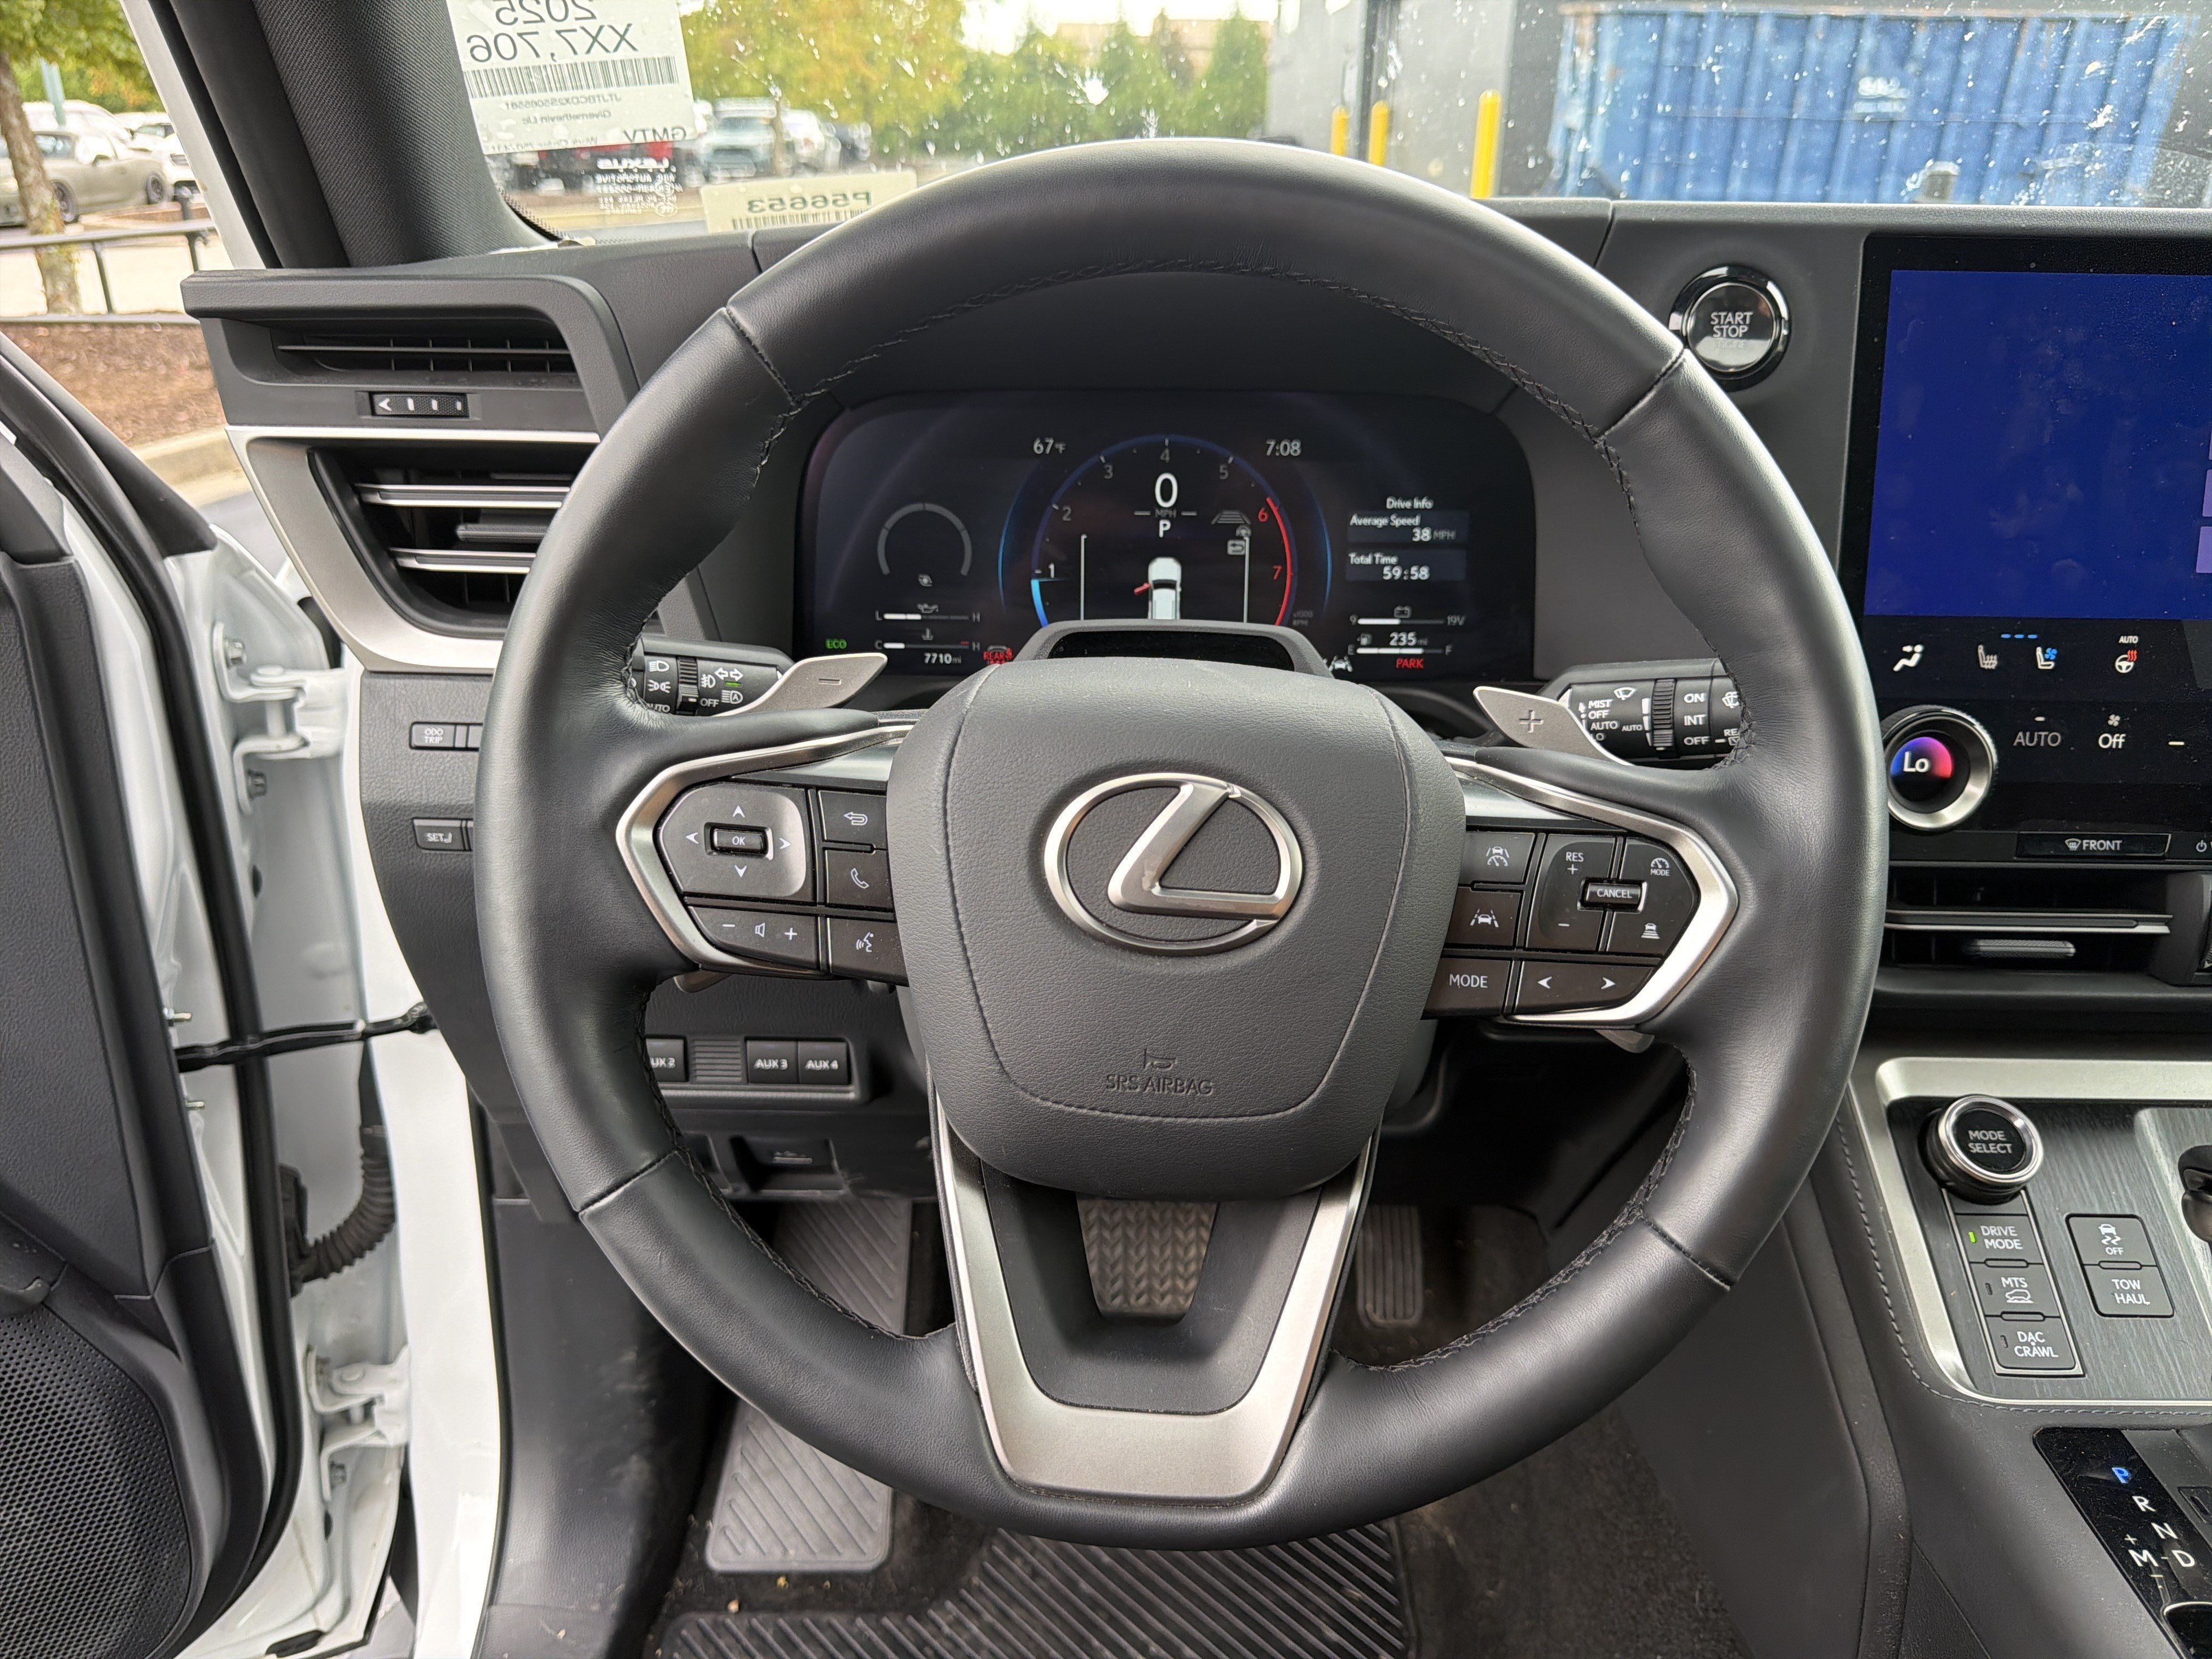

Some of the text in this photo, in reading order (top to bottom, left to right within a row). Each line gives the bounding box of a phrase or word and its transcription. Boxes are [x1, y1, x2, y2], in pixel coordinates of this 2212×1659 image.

[1710, 311, 1753, 325] START
[1713, 325, 1749, 338] STOP
[1266, 439, 1301, 456] 7:08
[1159, 448, 1170, 464] 4
[1103, 464, 1114, 479] 3
[1219, 464, 1229, 480] 5
[1155, 472, 1178, 507] 0
[1386, 495, 1435, 509] Drive Info
[1062, 505, 1072, 521] 2
[1258, 507, 1269, 522] 6
[1350, 512, 1421, 528] Average Speed
[1159, 520, 1171, 538] P
[1412, 527, 1432, 541] 38
[1348, 552, 1398, 565] Total Time
[1048, 562, 1055, 579] 1
[1272, 565, 1283, 580] 7
[1382, 565, 1430, 580] 59:58
[825, 637, 848, 649] ECO
[1389, 631, 1417, 645] 235
[2119, 635, 2138, 644] AUTO
[923, 652, 952, 664] 7710
[1396, 658, 1425, 669] PARK
[699, 698, 720, 708] OFF
[1589, 699, 1613, 708] MIST
[1684, 692, 1705, 703] ON
[1588, 709, 1609, 720] OFF
[1684, 714, 1706, 726] INT
[424, 727, 443, 736] ODO
[1590, 721, 1618, 731] AUTO
[1622, 724, 1643, 732] AUTO
[424, 736, 443, 744] TRIP
[1684, 736, 1711, 746] OFF
[2013, 732, 2062, 747] AUTO
[2098, 733, 2126, 749] Off
[1903, 751, 1930, 773] Lo
[426, 832, 444, 842] SET
[732, 836, 746, 846] OK
[2083, 839, 2123, 851] FRONT
[1566, 851, 1584, 862] RES
[1650, 868, 1671, 877] MODE
[1596, 888, 1633, 900] CANCEL
[1449, 973, 1488, 989] MODE
[650, 1057, 666, 1068] UX
[754, 1058, 780, 1069] AUX
[805, 1059, 830, 1070] AUX
[1106, 1074, 1214, 1096] SRS AIRBAG
[1968, 1130, 2006, 1141] MODE
[1968, 1142, 2012, 1154] SELECT
[1980, 1225, 2018, 1237] DRIVE
[1984, 1239, 2023, 1250] MODE
[2105, 1247, 2124, 1255] OFF
[2001, 1277, 2028, 1288] MTS
[2112, 1279, 2141, 1290] TOW
[2114, 1292, 2151, 1305] HAUL
[2017, 1331, 2045, 1343] DAC
[2014, 1346, 2058, 1358] CRAWL
[2112, 1466, 2129, 1483] P
[2132, 1496, 2157, 1512] R
[2151, 1522, 2179, 1539] N
[2128, 1549, 2159, 1567] M
[2171, 1549, 2195, 1567] D
